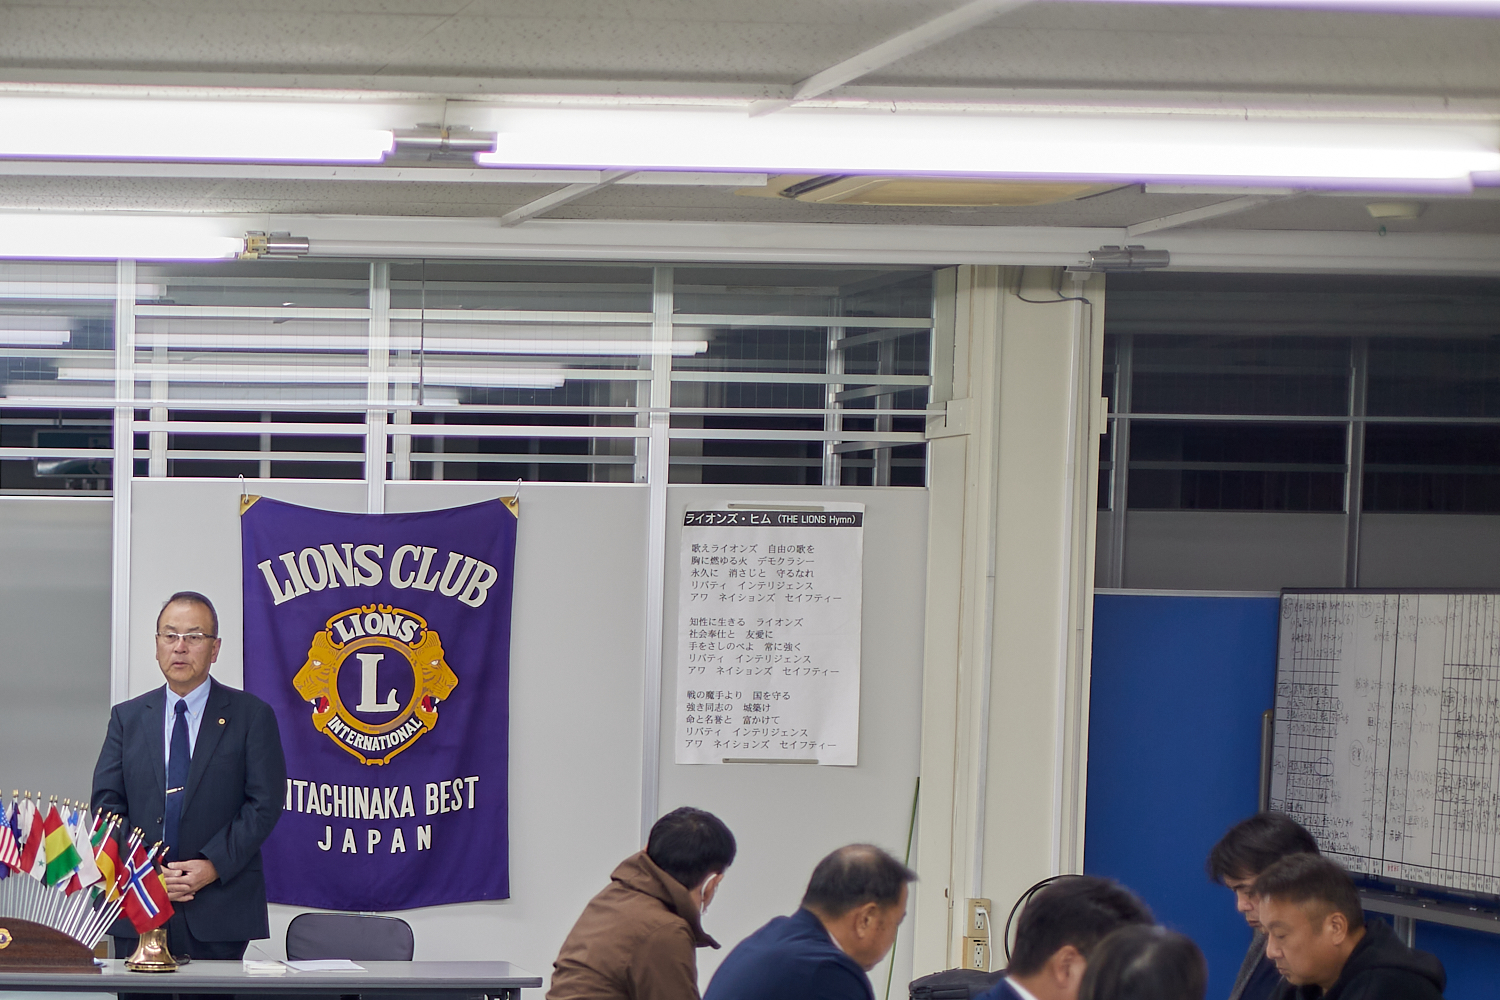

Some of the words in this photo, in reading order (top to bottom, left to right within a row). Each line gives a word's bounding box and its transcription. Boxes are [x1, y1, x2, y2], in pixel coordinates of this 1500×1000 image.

[684, 512, 772, 525] ライオンズ・ヒム
[801, 514, 827, 524] LIONS
[691, 543, 759, 555] 歌えライオンズ
[768, 543, 815, 555] 自由の歌を
[690, 555, 748, 567] 胸に燃ゆる火
[757, 555, 815, 567] デモクラシー
[257, 543, 384, 606] LIONS
[390, 544, 498, 608] CLUB
[690, 567, 719, 579] 永久に
[776, 568, 815, 579] 守るなれ
[737, 580, 814, 591] インテリジェンス
[690, 592, 709, 602] アワ
[718, 592, 776, 603] ネイションズ
[784, 593, 842, 603] セイフティー
[333, 612, 420, 644] LIONS
[688, 616, 746, 628] 知性に生きる
[756, 617, 804, 628] ライオンズ
[688, 628, 735, 640] 社会奉仕と
[745, 629, 774, 640] 友愛に
[688, 641, 754, 652] 手をさしのべよ
[763, 641, 802, 653] 常に強く
[735, 654, 812, 665] インテリジェンス
[688, 665, 706, 676] アワ
[716, 665, 773, 676] ネイションズ
[782, 666, 840, 677] セイフティー
[356, 653, 401, 713] L
[686, 689, 742, 701] 戦の魔手より
[752, 690, 791, 701] 国を守る
[686, 701, 734, 713] 強き同志の
[742, 702, 772, 713] 城築け
[685, 714, 732, 725] 命と名誉と
[327, 717, 423, 752] INTERNATIONAL
[732, 727, 809, 738] インテリジェンス
[685, 739, 703, 749] アワ
[713, 739, 770, 750] ネイションズ
[779, 740, 837, 751] セイフティー
[283, 778, 416, 820] ITACHINAKA
[426, 776, 480, 816] BEST
[317, 824, 432, 855] JAPAN
